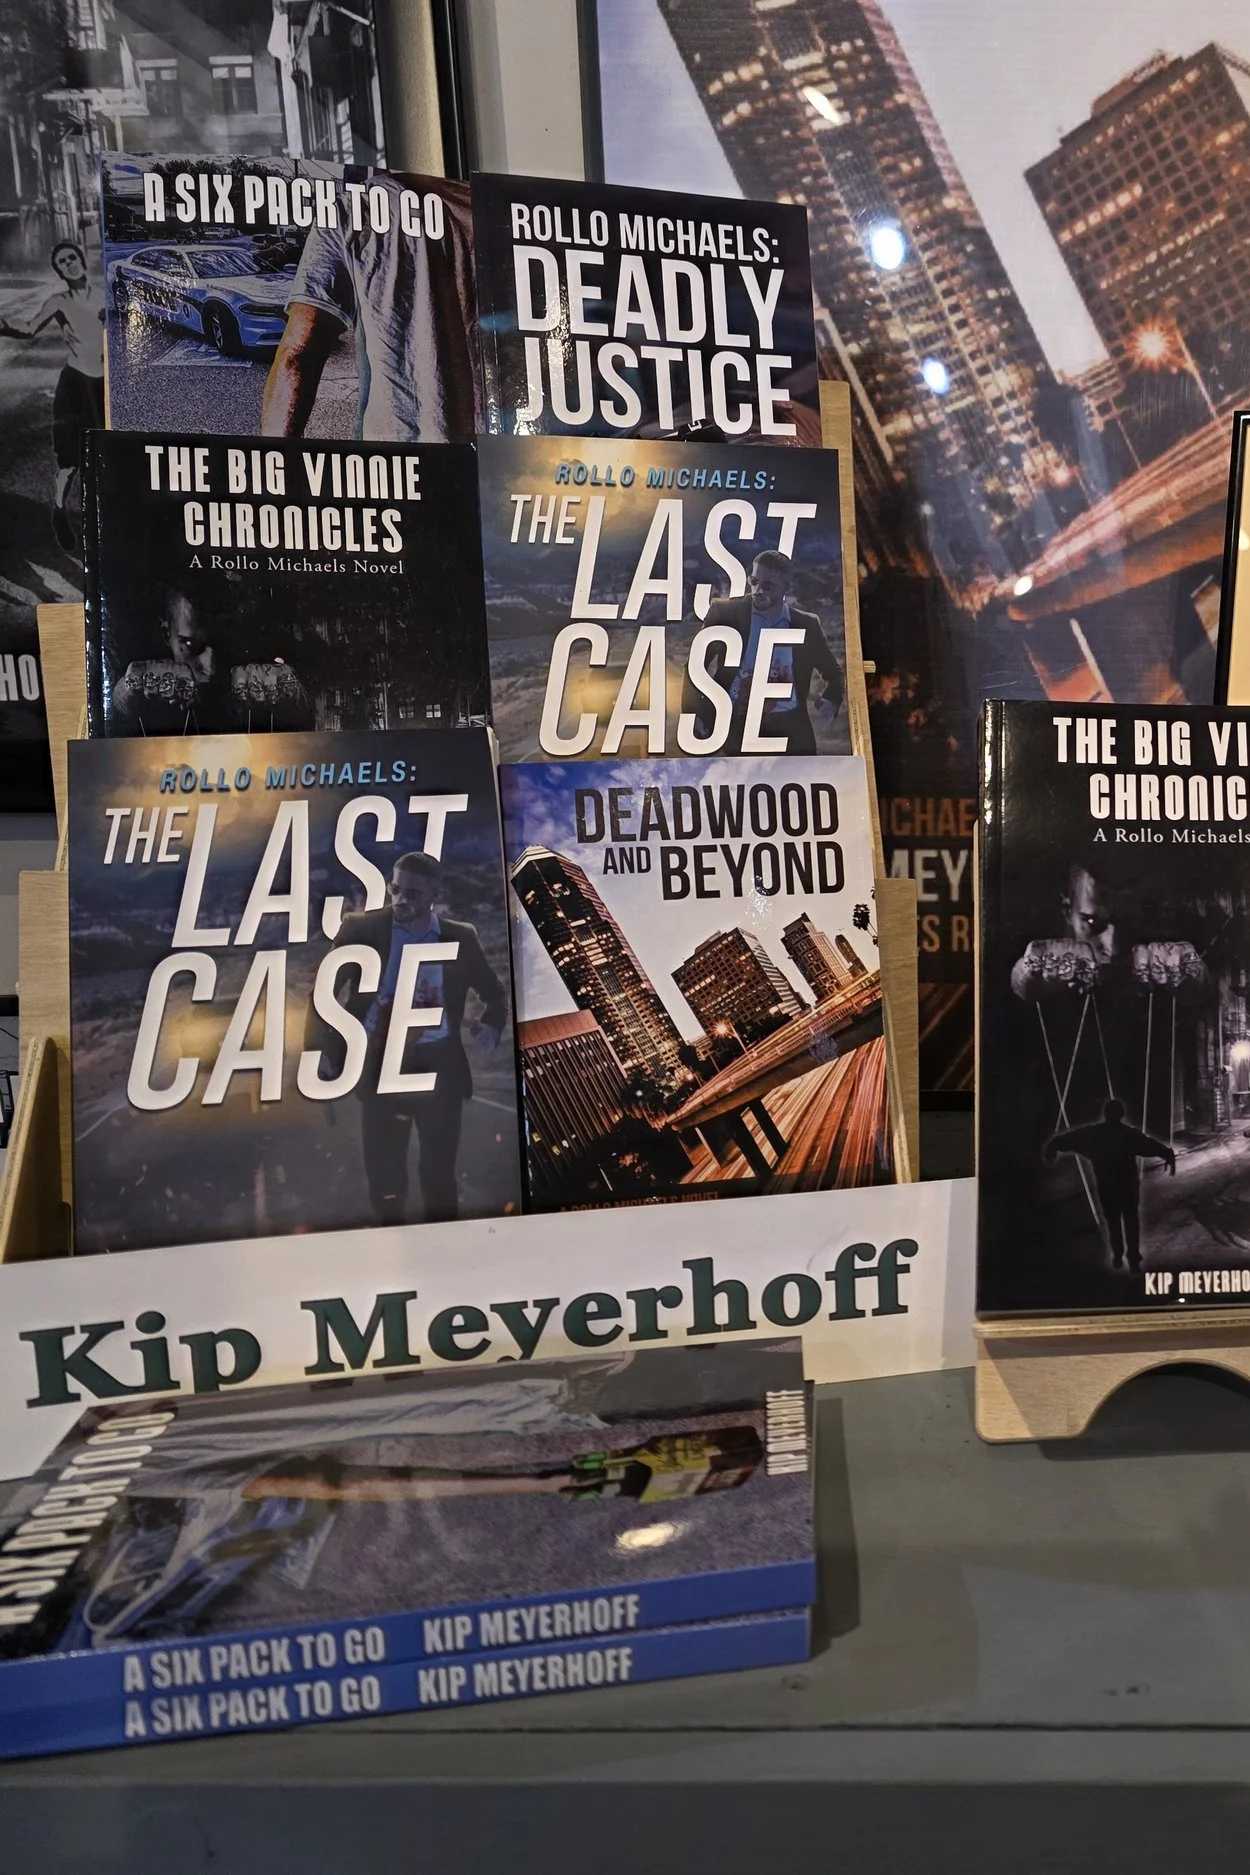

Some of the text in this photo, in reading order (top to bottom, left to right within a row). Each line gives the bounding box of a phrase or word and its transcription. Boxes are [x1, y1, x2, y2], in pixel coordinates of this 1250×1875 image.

[143, 172, 445, 240] A SIX PACK TO GO
[510, 203, 779, 263] ROLLO MICHAELS:
[513, 244, 784, 350] DEADLY
[516, 336, 797, 436] JUSTICE
[145, 445, 421, 500] THE BIG VINNIE
[555, 463, 775, 490] ROLLO MICHAELS:
[184, 501, 403, 554] CHRONICLES
[510, 494, 817, 621] THE LAST
[189, 555, 403, 574] A Rollo Michaels Novel
[539, 622, 806, 755] CASE
[1053, 717, 1117, 765] THE
[1134, 719, 1191, 767] BIG
[160, 760, 417, 793] ROLLO MICHAELS:
[574, 783, 839, 844] DEADWOOD
[1093, 827, 1108, 843] A
[1114, 827, 1164, 844] Rollo
[103, 794, 468, 947] THE LAST
[603, 841, 845, 900] AND BEYOND
[127, 942, 460, 1110] CASE
[1144, 1271, 1173, 1296] KIP
[19, 1238, 918, 1408] Kip Meyerhoff
[86, 1412, 175, 1445] GO
[58, 1445, 153, 1481] TO
[3, 1477, 131, 1551] PACK
[123, 1594, 640, 1694] A SIX PACK TO GO KIP MEYERHOFF
[124, 1647, 634, 1739] A SIX PACK TO GO KIP MEYERHOFF
